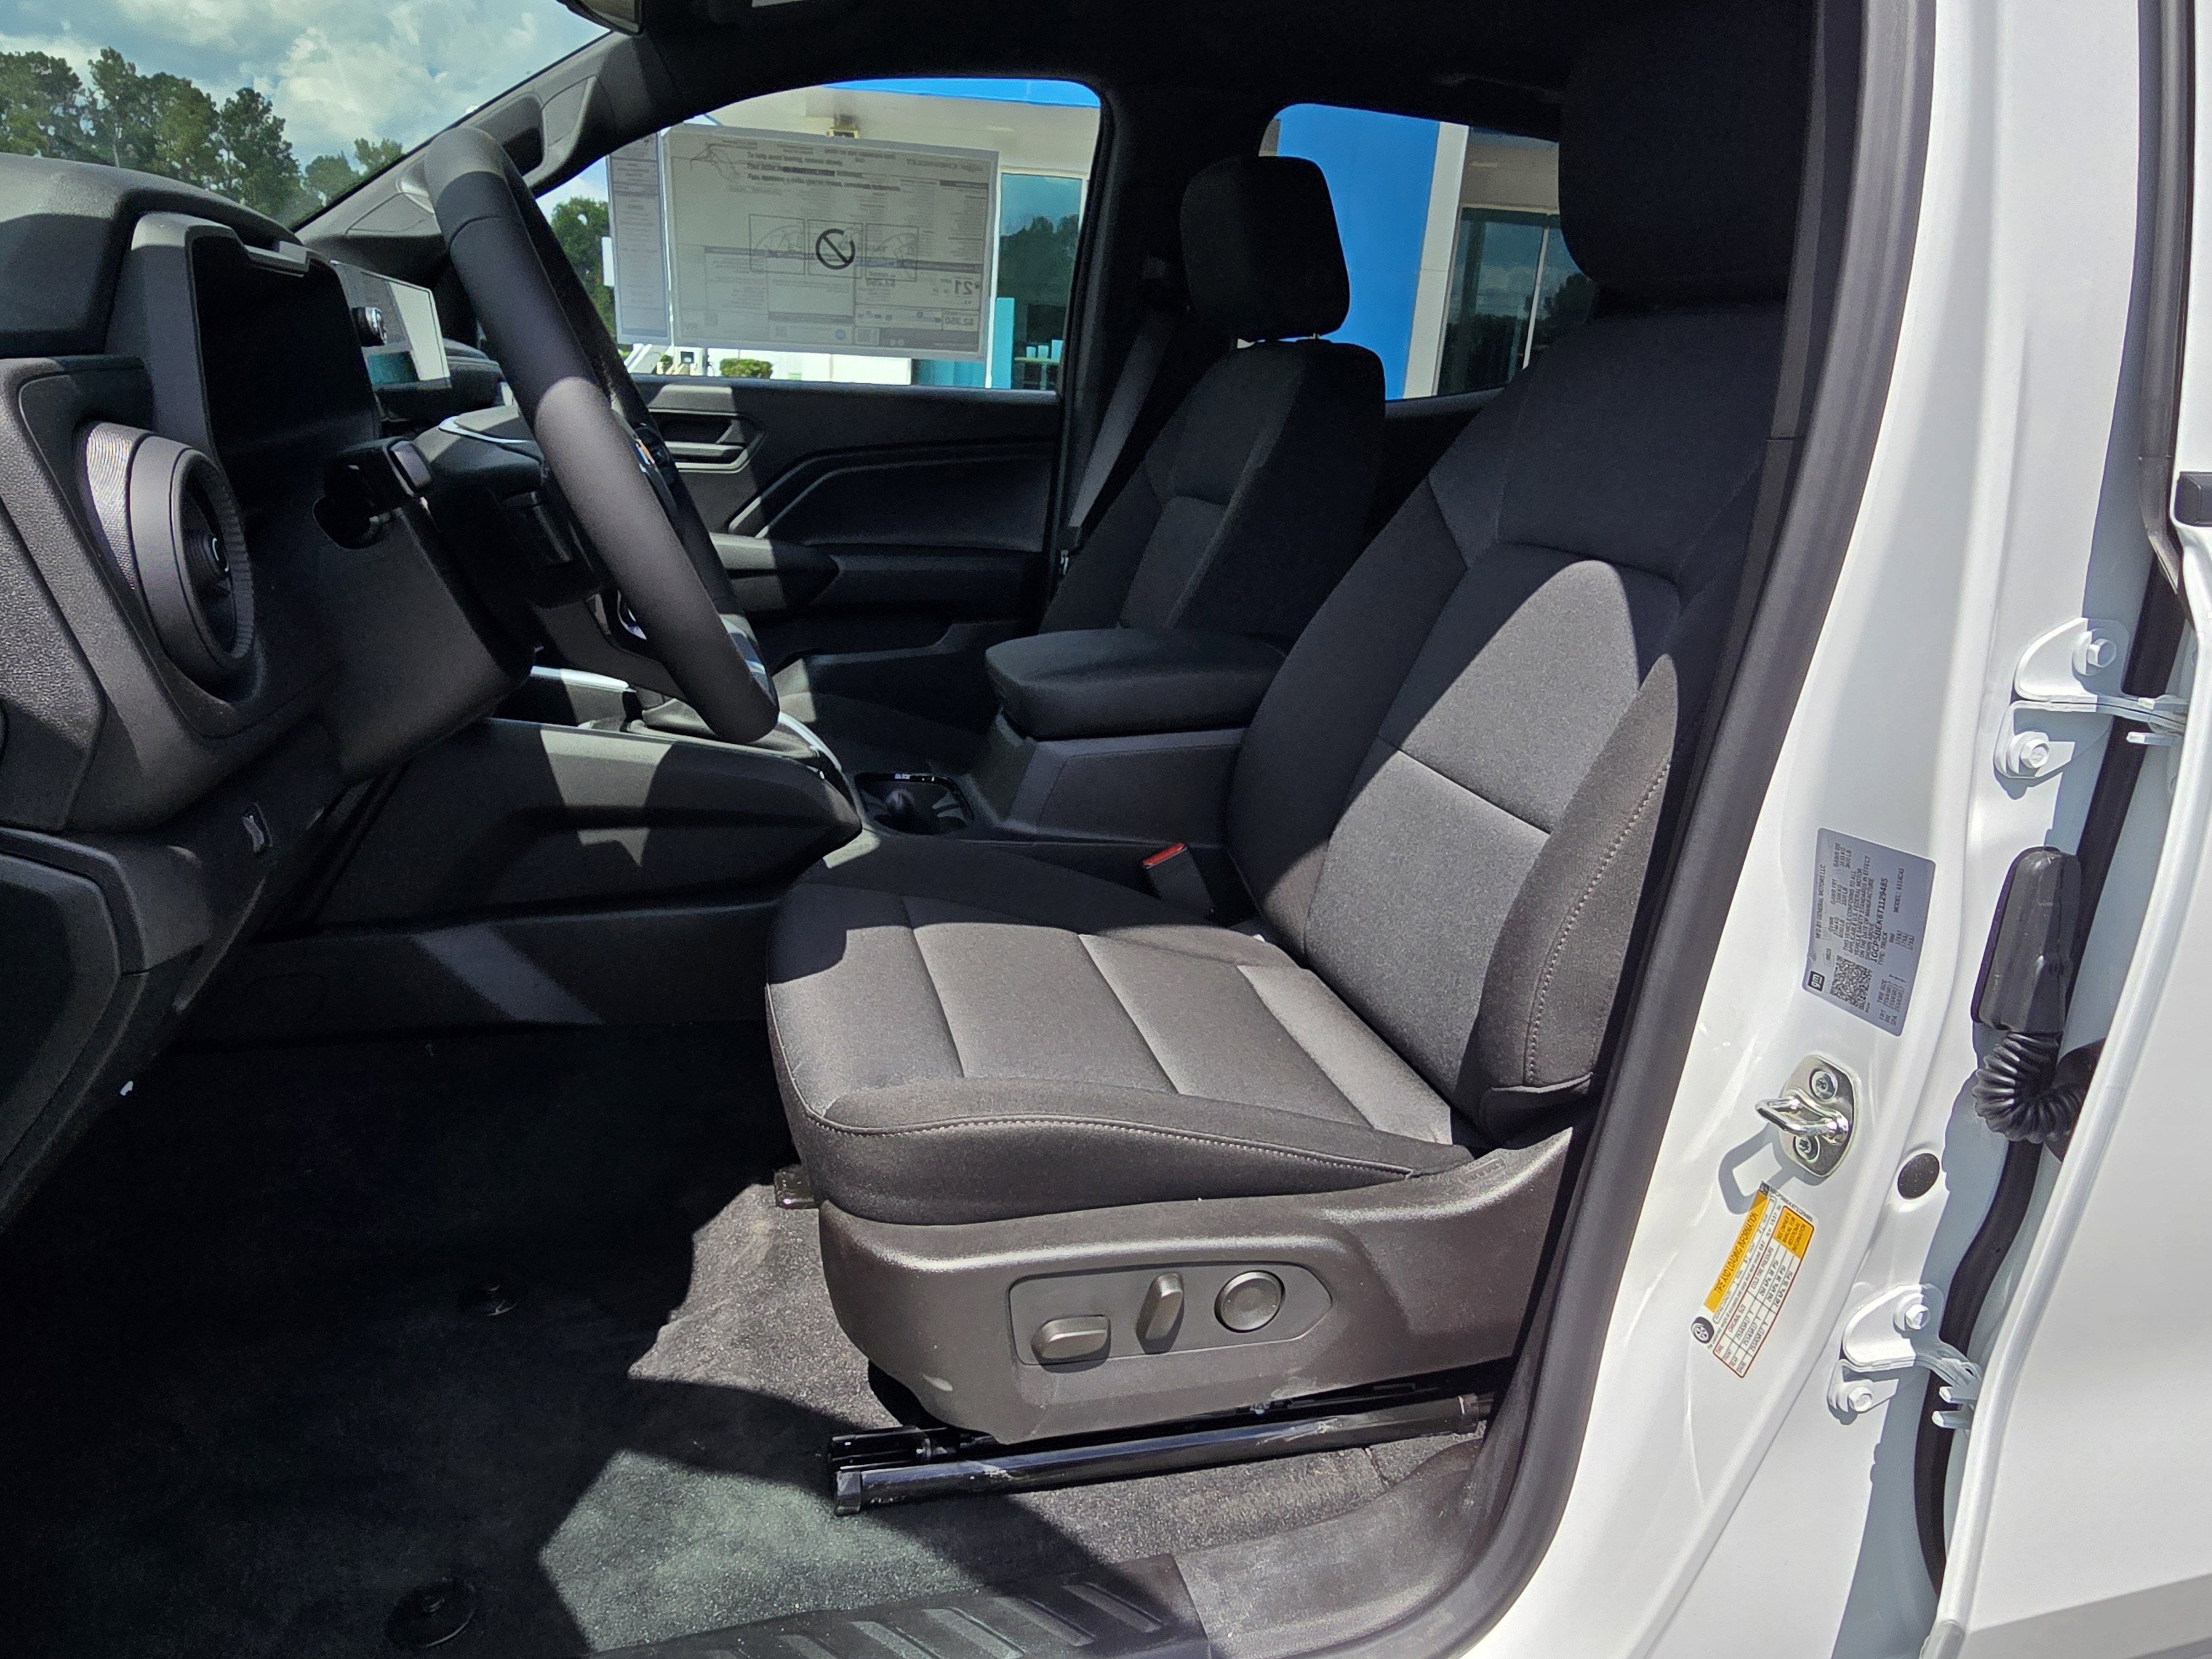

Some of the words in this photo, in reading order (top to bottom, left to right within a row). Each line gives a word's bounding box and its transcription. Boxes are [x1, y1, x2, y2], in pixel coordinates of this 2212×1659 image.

[1862, 855, 1871, 876] EFFECT
[1849, 878, 1855, 888] TO
[1846, 887, 1855, 918] CONFORMS
[1858, 881, 1867, 914] STANDARDS
[1864, 877, 1874, 917] MANUFACTURE
[1892, 890, 1902, 914] MODEL:
[1816, 920, 1821, 928] BY
[1863, 916, 1869, 925] OF
[1859, 948, 1865, 959] ON
[1735, 1209, 1759, 1249] INFORMATION
[1775, 1229, 1783, 1240] SEE
[1781, 1225, 1792, 1244] MANUAL
[1787, 1215, 1796, 1228] FOR
[1786, 1220, 1802, 1247] ADDITIONAL
[1791, 1222, 1808, 1252] INFORMATION
[1725, 1244, 1743, 1271] LOADING
[1770, 1258, 1779, 1270] PSI
[1719, 1266, 1733, 1284] AND
[1777, 1264, 1786, 1275] PSI
[1785, 1269, 1793, 1280] PSI
[1713, 1279, 1726, 1296] TIRE
[1750, 1274, 1760, 1290] COLD
